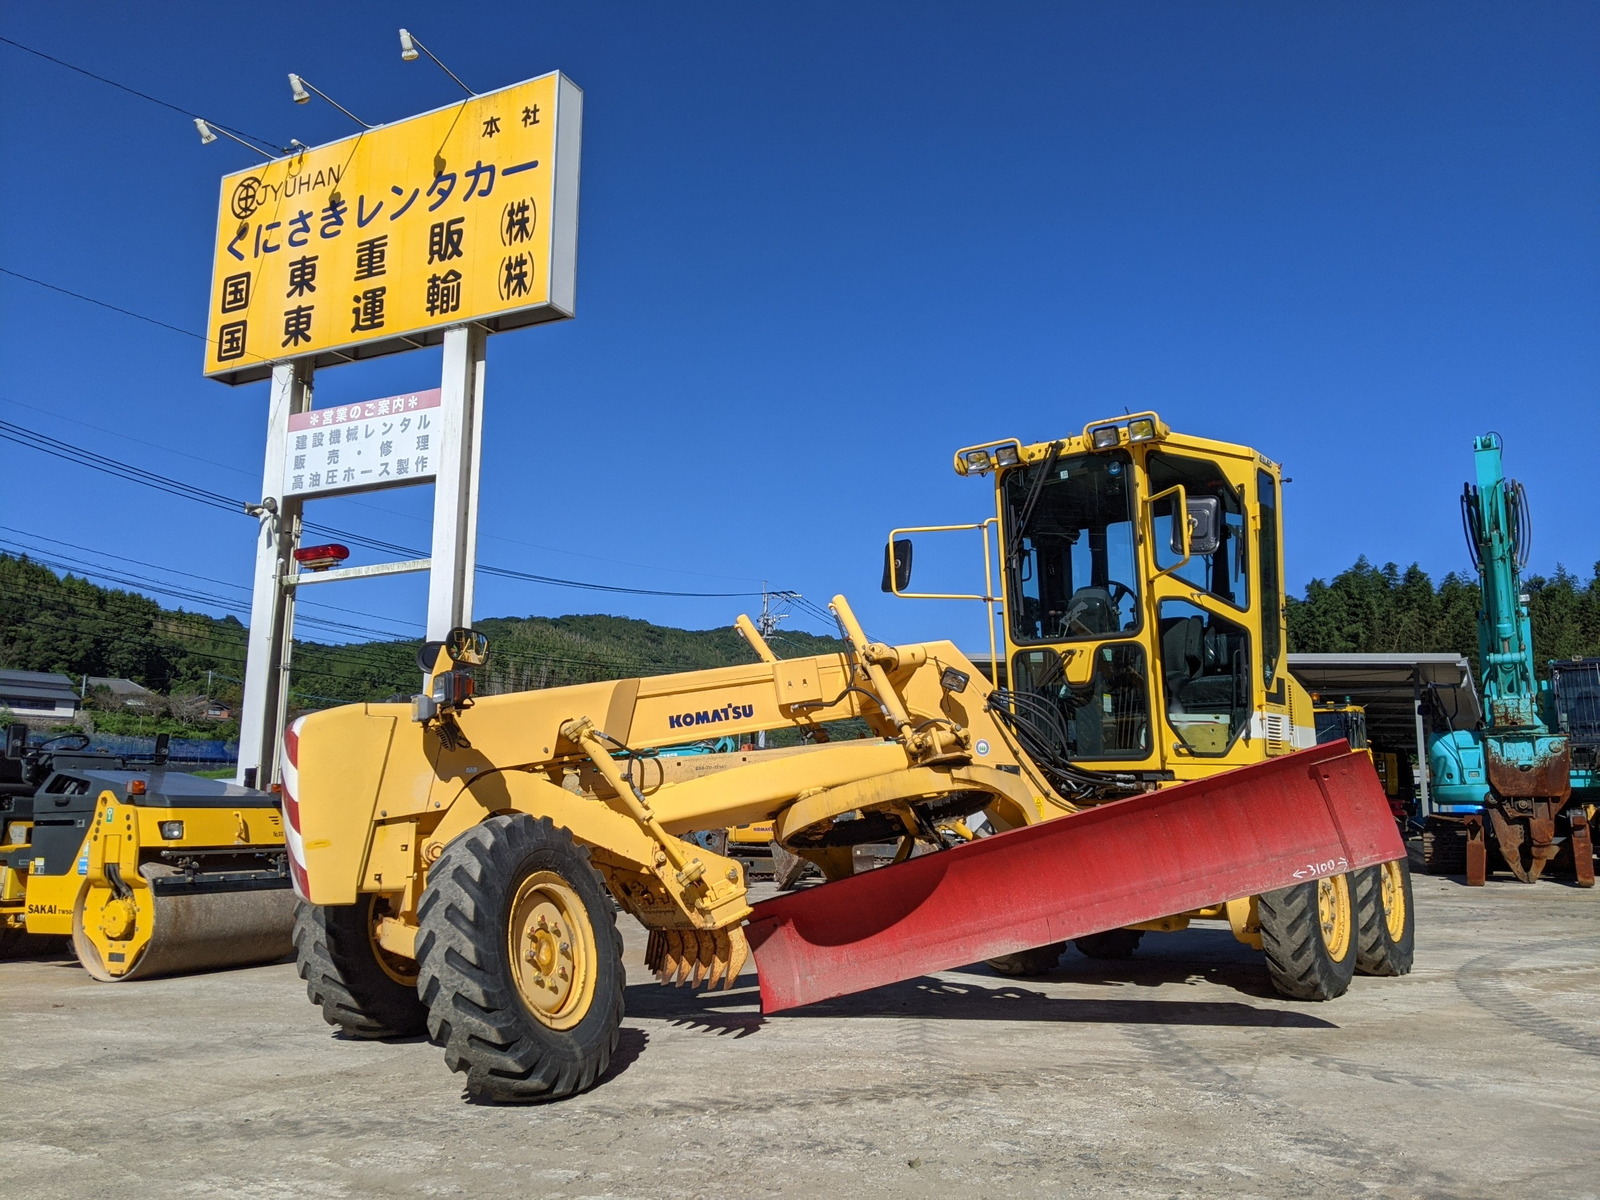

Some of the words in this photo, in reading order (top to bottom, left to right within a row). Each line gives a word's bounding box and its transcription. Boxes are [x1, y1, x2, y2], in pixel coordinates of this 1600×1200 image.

[256, 164, 341, 206] JYUHAN
[227, 160, 539, 261] くにさきレンタカー
[295, 414, 431, 451] 建設機械レンタル
[291, 455, 429, 491] 高油圧ホース製作
[669, 703, 754, 729] KOMATSU
[1306, 859, 1335, 876] 3100
[28, 904, 57, 915] SAKAI
